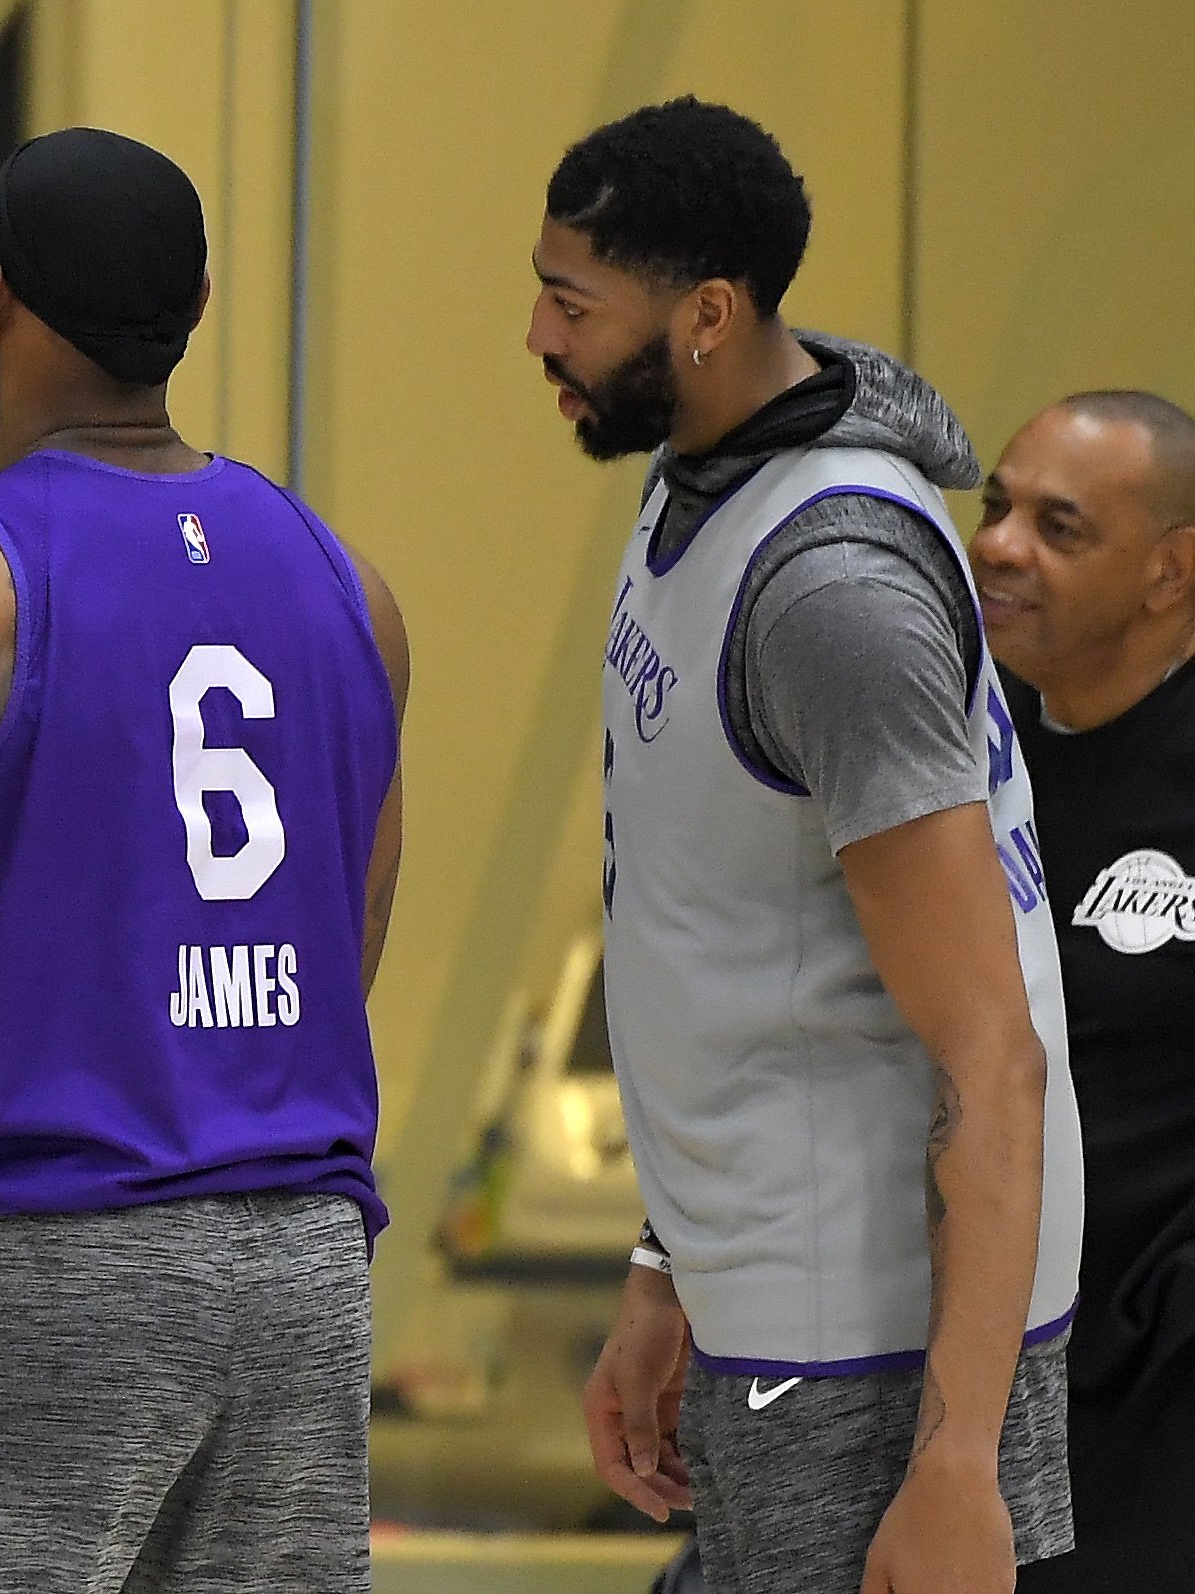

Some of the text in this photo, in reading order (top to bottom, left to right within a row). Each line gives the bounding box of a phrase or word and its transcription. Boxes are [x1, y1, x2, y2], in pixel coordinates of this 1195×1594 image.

[168, 644, 286, 901] 6
[1085, 876, 1195, 932] LAKER
[169, 943, 301, 1029] JAMES
